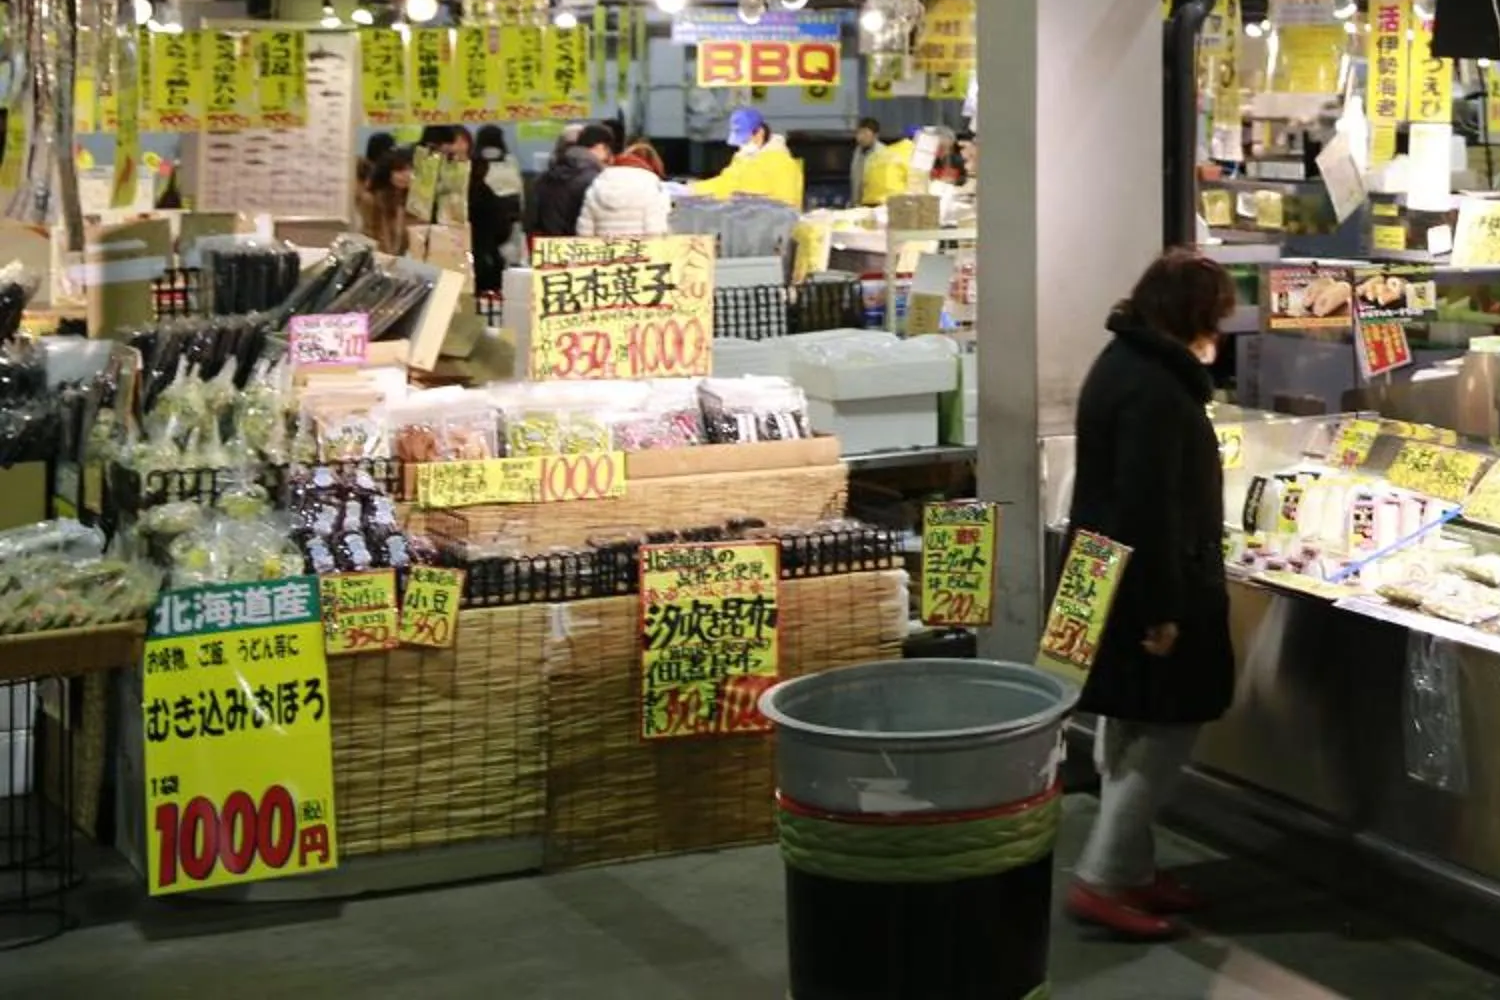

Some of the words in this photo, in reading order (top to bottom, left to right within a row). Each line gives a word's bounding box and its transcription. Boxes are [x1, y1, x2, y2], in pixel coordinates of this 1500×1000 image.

[702, 42, 837, 83] BBQ
[540, 262, 678, 320] 昆布菓子
[539, 454, 615, 502] 1000
[155, 582, 312, 635] 北海道産
